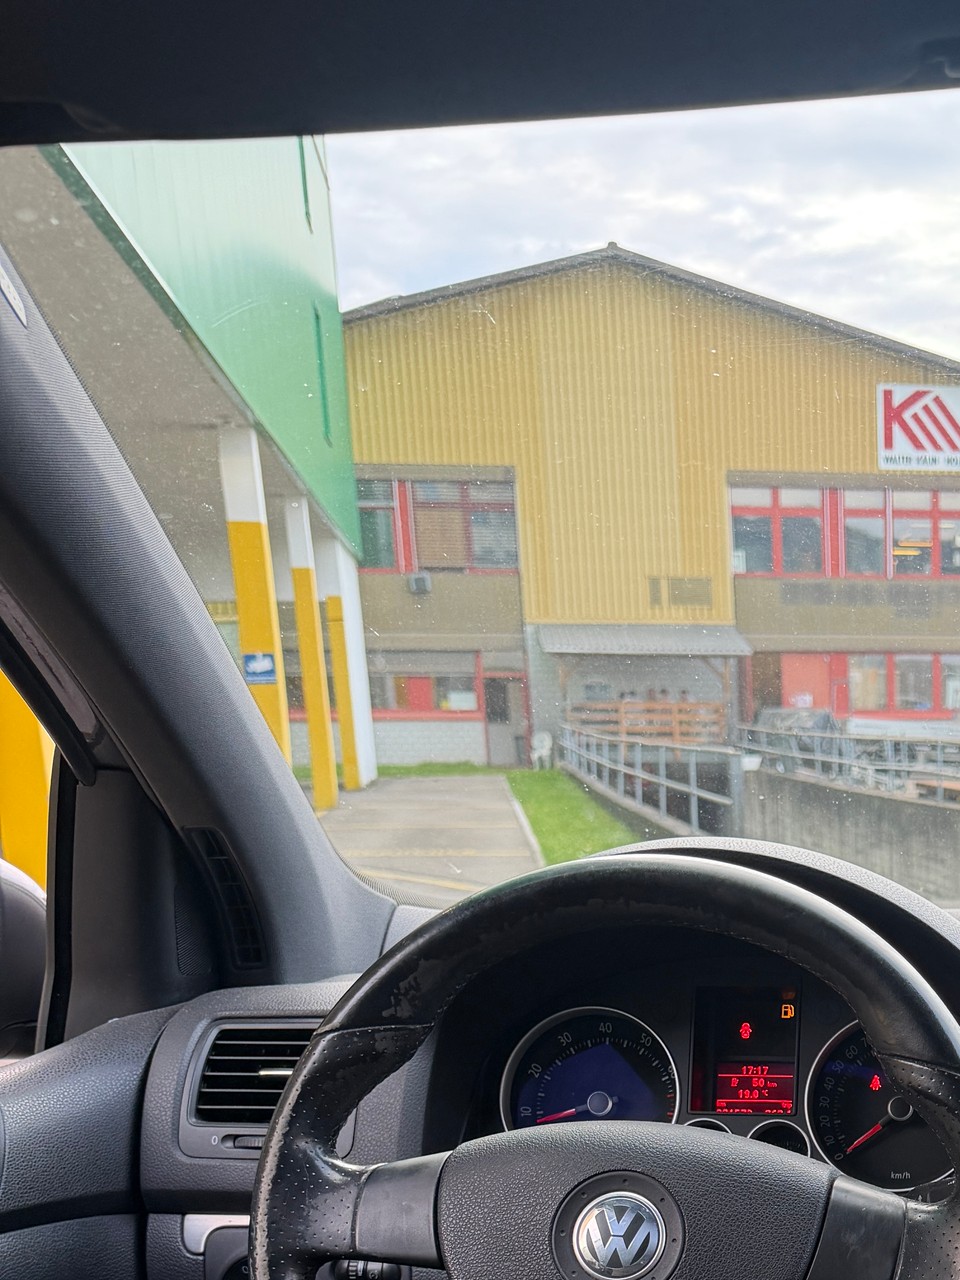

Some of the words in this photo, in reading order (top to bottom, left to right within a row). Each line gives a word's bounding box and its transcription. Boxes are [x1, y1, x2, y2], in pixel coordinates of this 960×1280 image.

[598, 1022, 613, 1033] 40
[558, 1032, 572, 1047] 30
[639, 1033, 652, 1047] 50
[845, 1045, 858, 1059] 60
[528, 1063, 542, 1078] 20
[741, 1066, 769, 1075] 17:17
[832, 1060, 845, 1074] 50
[752, 1078, 765, 1087] 50
[824, 1076, 835, 1091] 40
[738, 1089, 759, 1098] 19.0
[819, 1096, 830, 1109] 30
[520, 1106, 532, 1117] 10
[819, 1115, 831, 1128] 20
[823, 1135, 835, 1147] 10
[834, 1153, 844, 1161] 0
[890, 1171, 911, 1180] km/h
